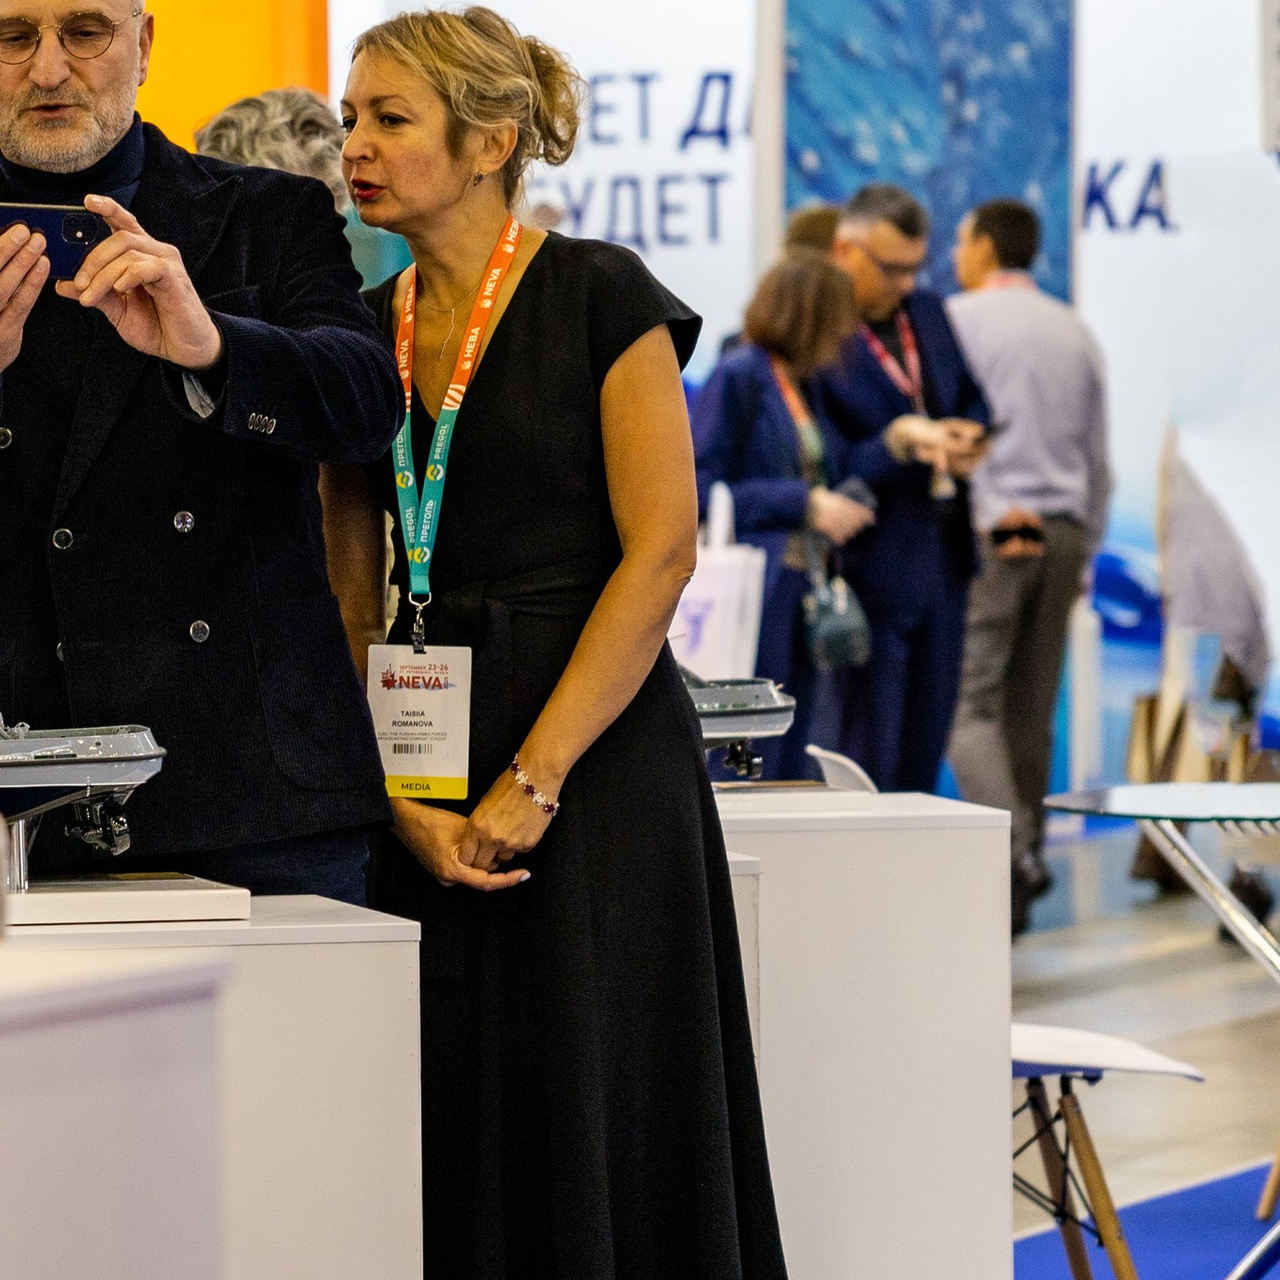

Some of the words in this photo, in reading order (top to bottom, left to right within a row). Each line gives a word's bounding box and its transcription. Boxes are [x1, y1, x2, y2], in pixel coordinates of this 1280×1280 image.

[677, 70, 751, 151] Д
[483, 268, 502, 297] NEVA
[399, 338, 410, 369] NEVA
[433, 423, 449, 460] PREGOL
[420, 499, 434, 543] ПРЕГОЛЬ
[428, 663, 449, 671] 23-26
[398, 675, 443, 690] NEVA
[401, 782, 431, 791] MEDIA
